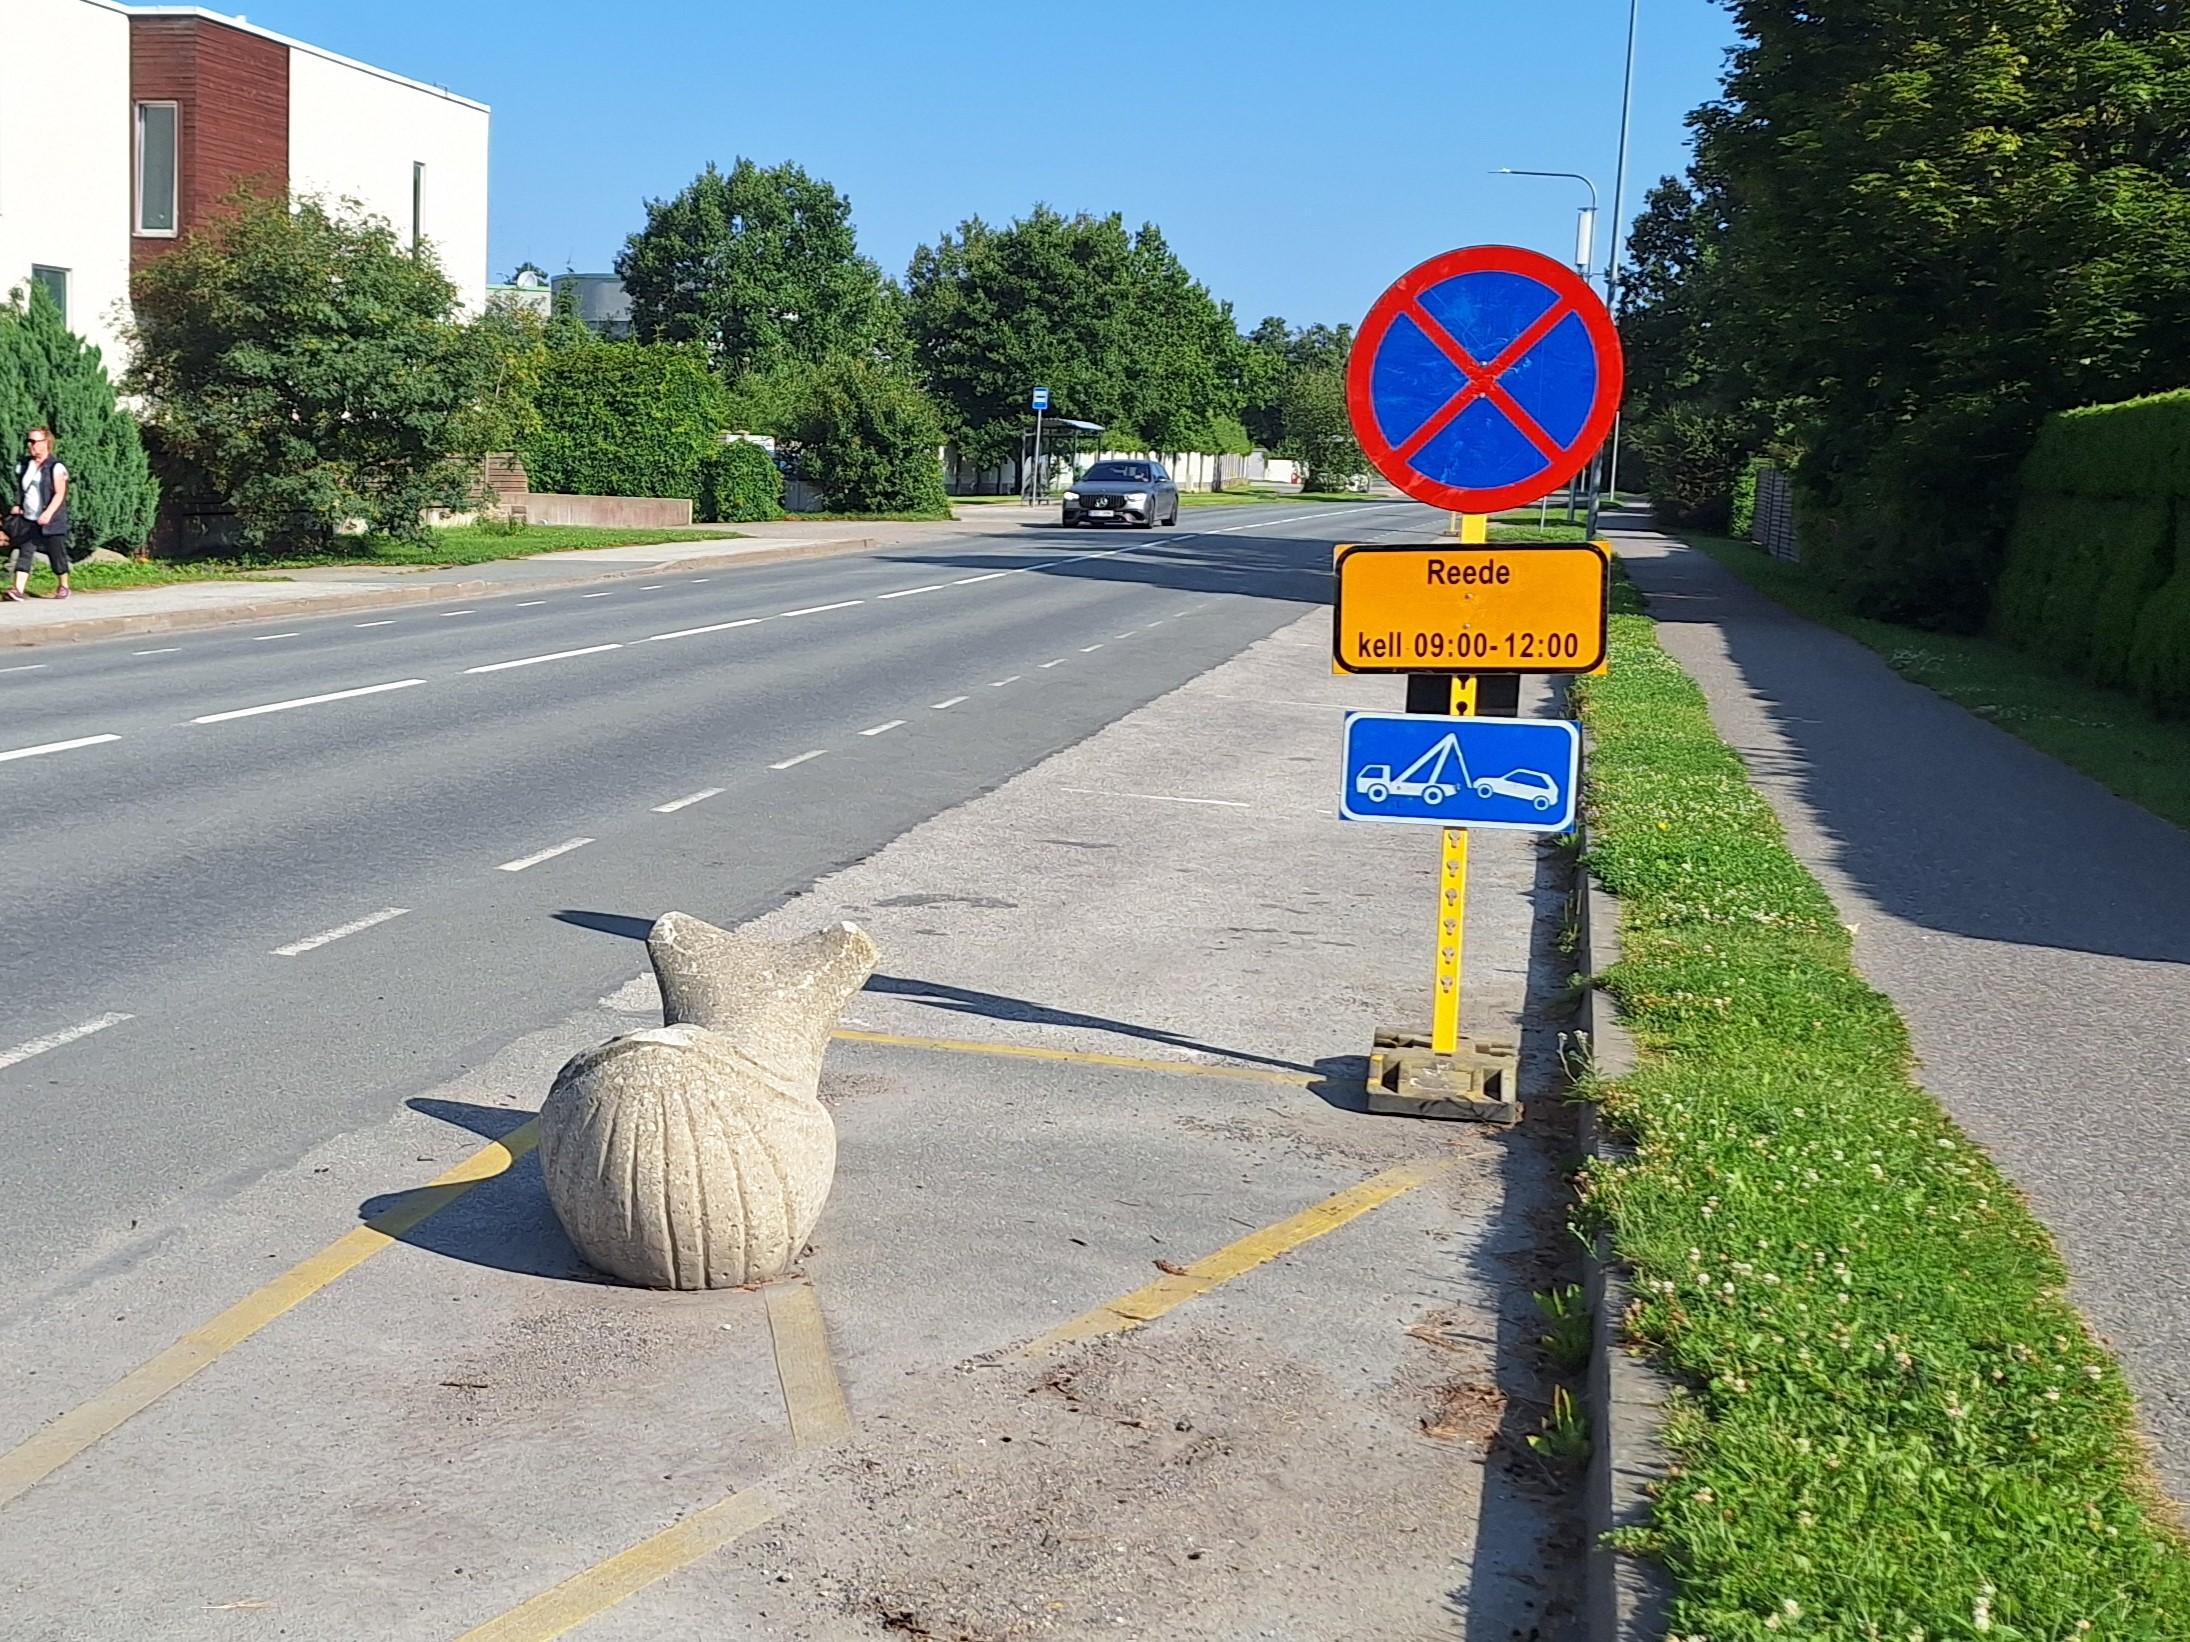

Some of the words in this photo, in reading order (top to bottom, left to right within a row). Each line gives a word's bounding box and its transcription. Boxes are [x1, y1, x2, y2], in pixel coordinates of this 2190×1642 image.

[1427, 559, 1510, 584] Reede
[1358, 632, 1401, 657] kell
[1414, 632, 1579, 657] 09:00-12:00
